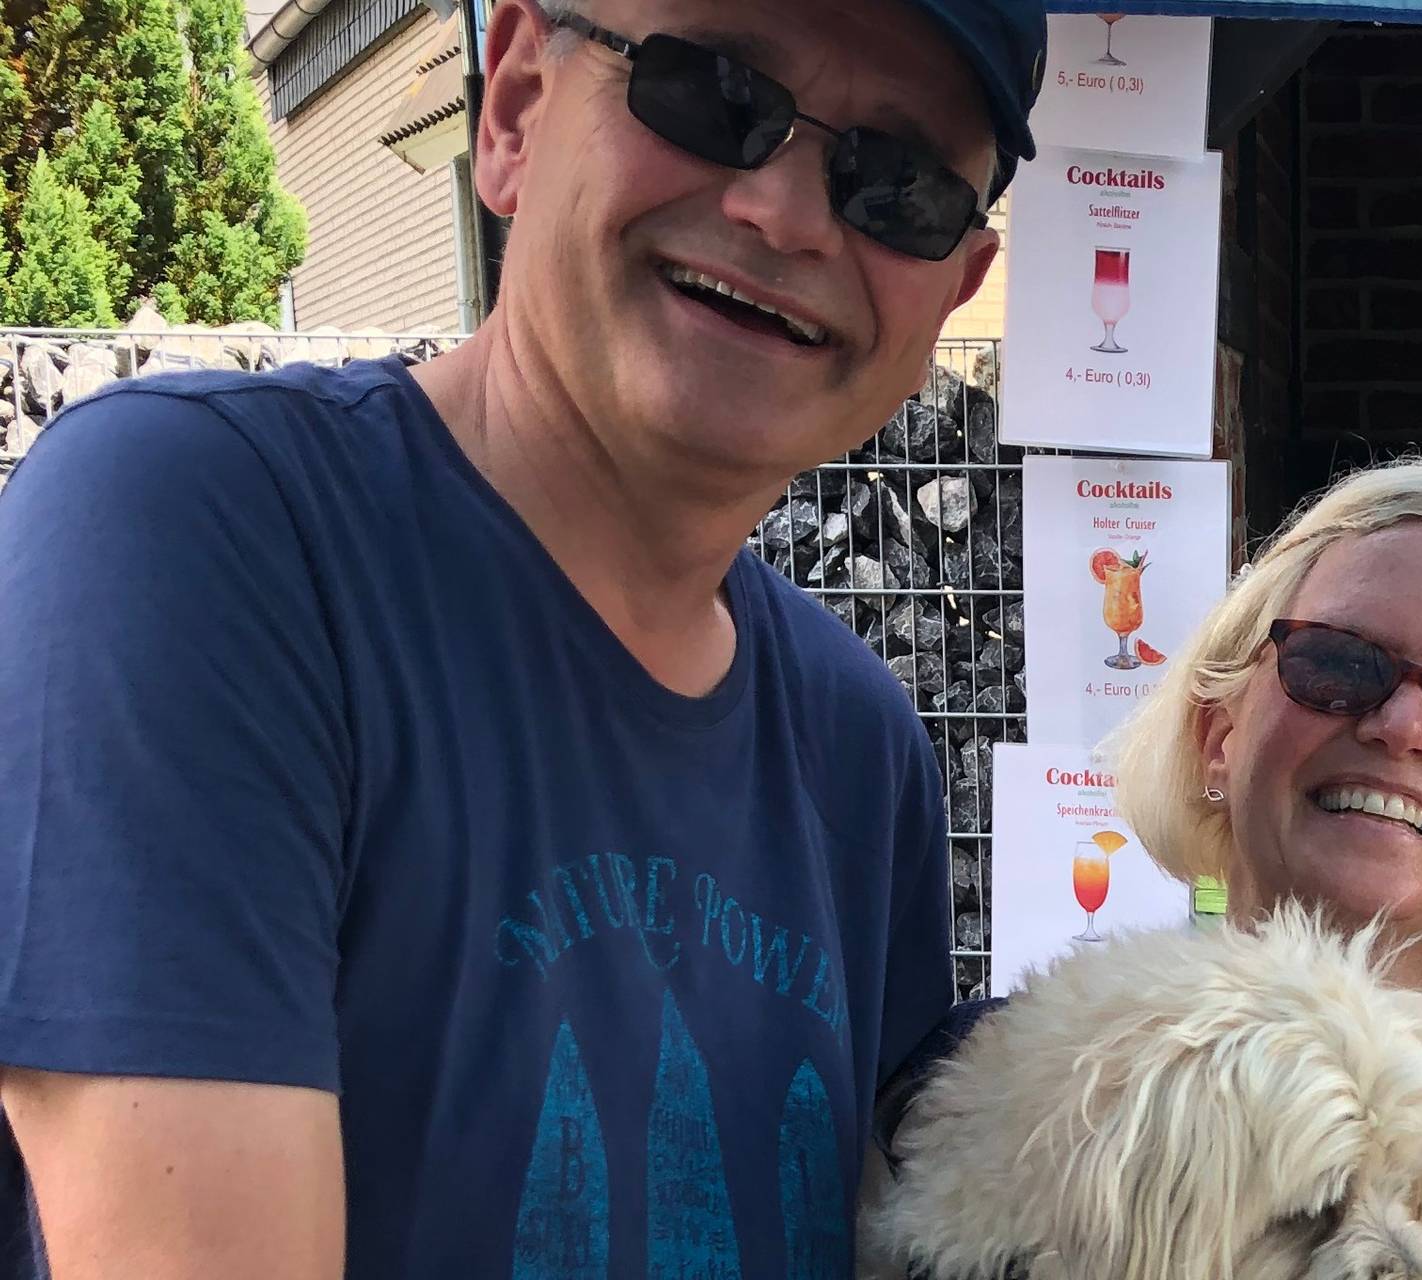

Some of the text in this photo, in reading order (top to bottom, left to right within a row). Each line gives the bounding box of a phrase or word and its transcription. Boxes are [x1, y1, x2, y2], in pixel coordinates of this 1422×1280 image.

[1057, 71, 1073, 87] 5,-
[1077, 72, 1106, 89] Euro
[1066, 165, 1165, 190] Cocktails
[1088, 203, 1140, 220] Sattelflitzer
[1065, 367, 1082, 382] 4,-
[1085, 368, 1113, 384] Euro
[1077, 479, 1173, 499] Cocktails
[1093, 516, 1157, 530] Holter Cruiser
[1104, 682, 1131, 696] Euro
[693, 871, 848, 1048] POWE
